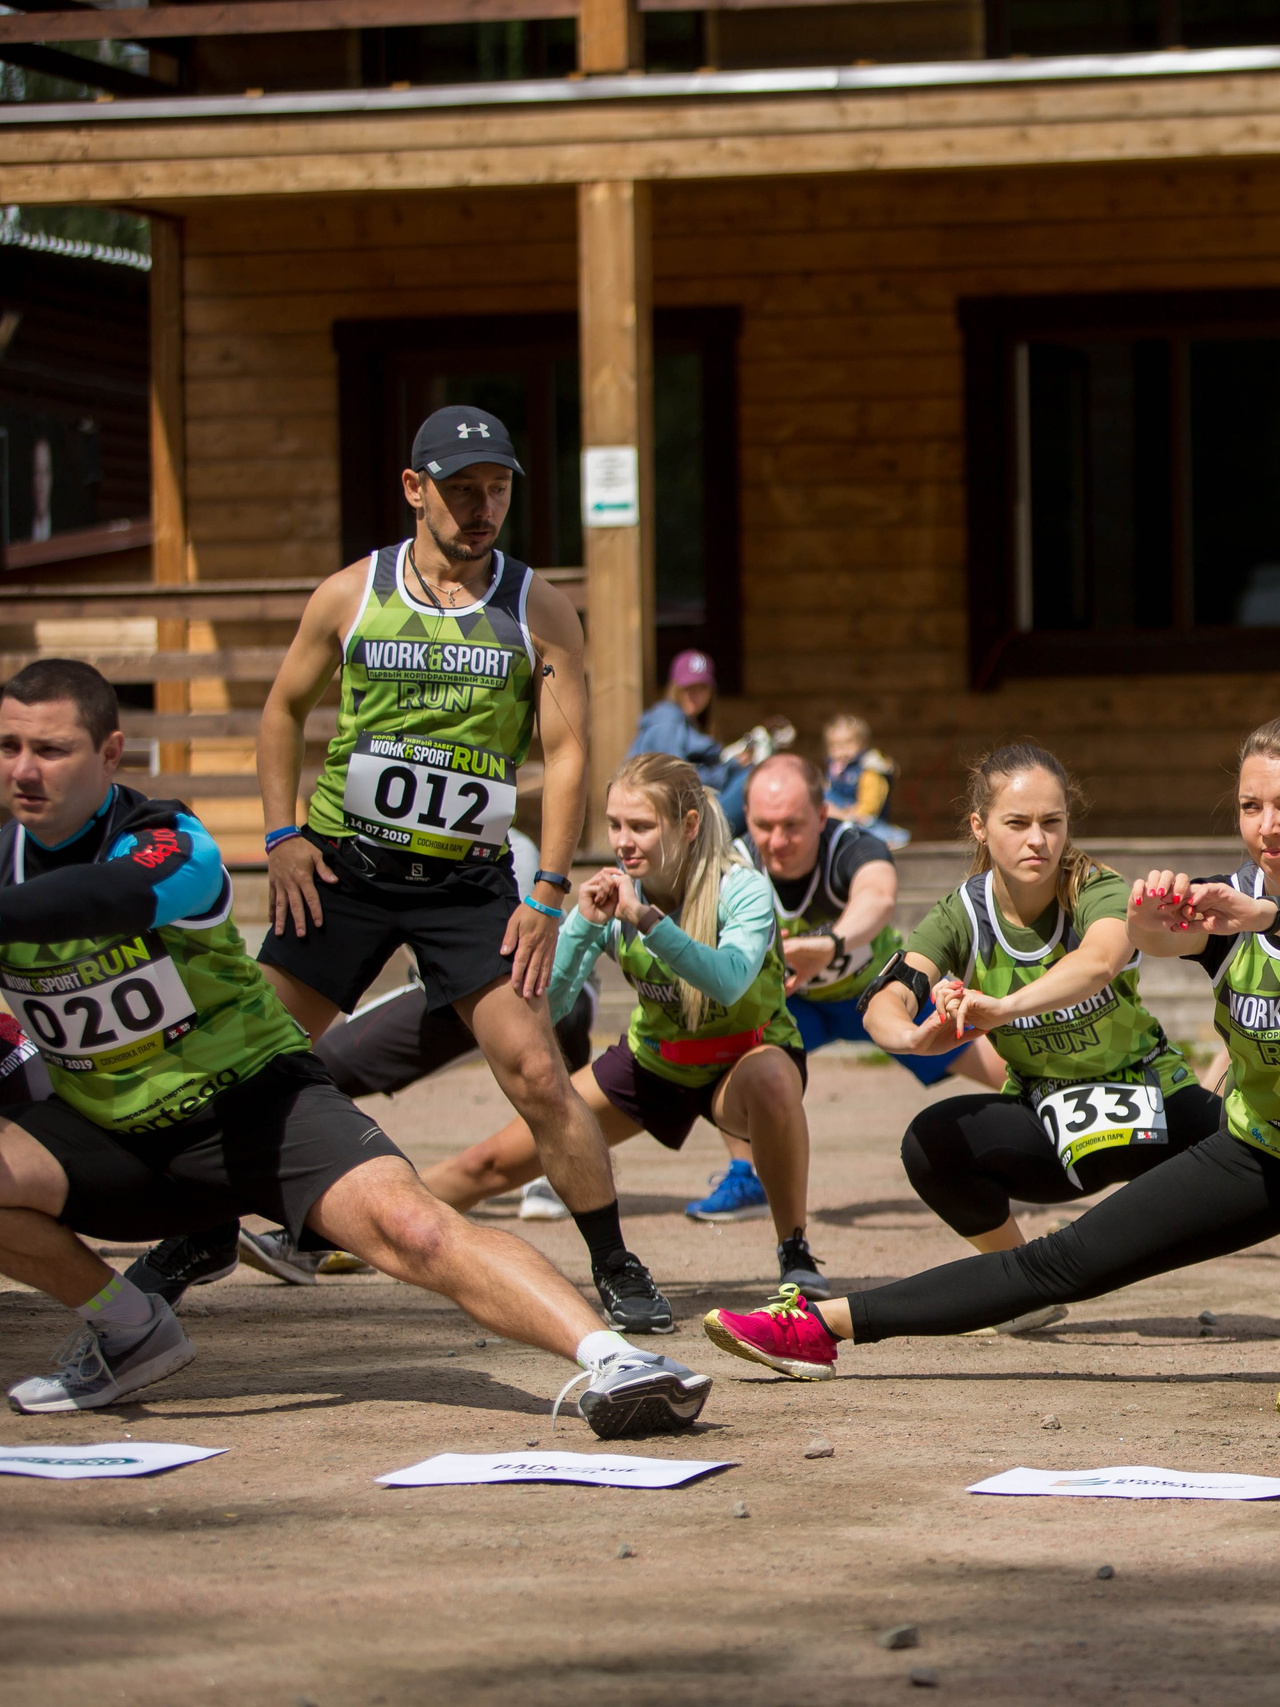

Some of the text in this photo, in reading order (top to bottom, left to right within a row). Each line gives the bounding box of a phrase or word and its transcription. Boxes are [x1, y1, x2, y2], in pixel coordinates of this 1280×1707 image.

[365, 642, 513, 678] WORK&SPORT
[403, 672, 478, 684] КОРПОРАТИВНЫЙ
[399, 682, 472, 713] RUN
[370, 740, 506, 780] WORK&SPORT RUN
[374, 765, 490, 836] 012
[350, 816, 411, 845] 14.07.2019
[2, 936, 151, 993] WORK&SPORT RUN
[23, 977, 166, 1049] 020
[100, 1040, 158, 1067] СОСНОВКА ПАРК
[1029, 1025, 1099, 1056] RUN
[1040, 1086, 1141, 1153] 033
[1075, 1134, 1107, 1152] СОСНОВКА
[1107, 1132, 1125, 1142] ПАРК
